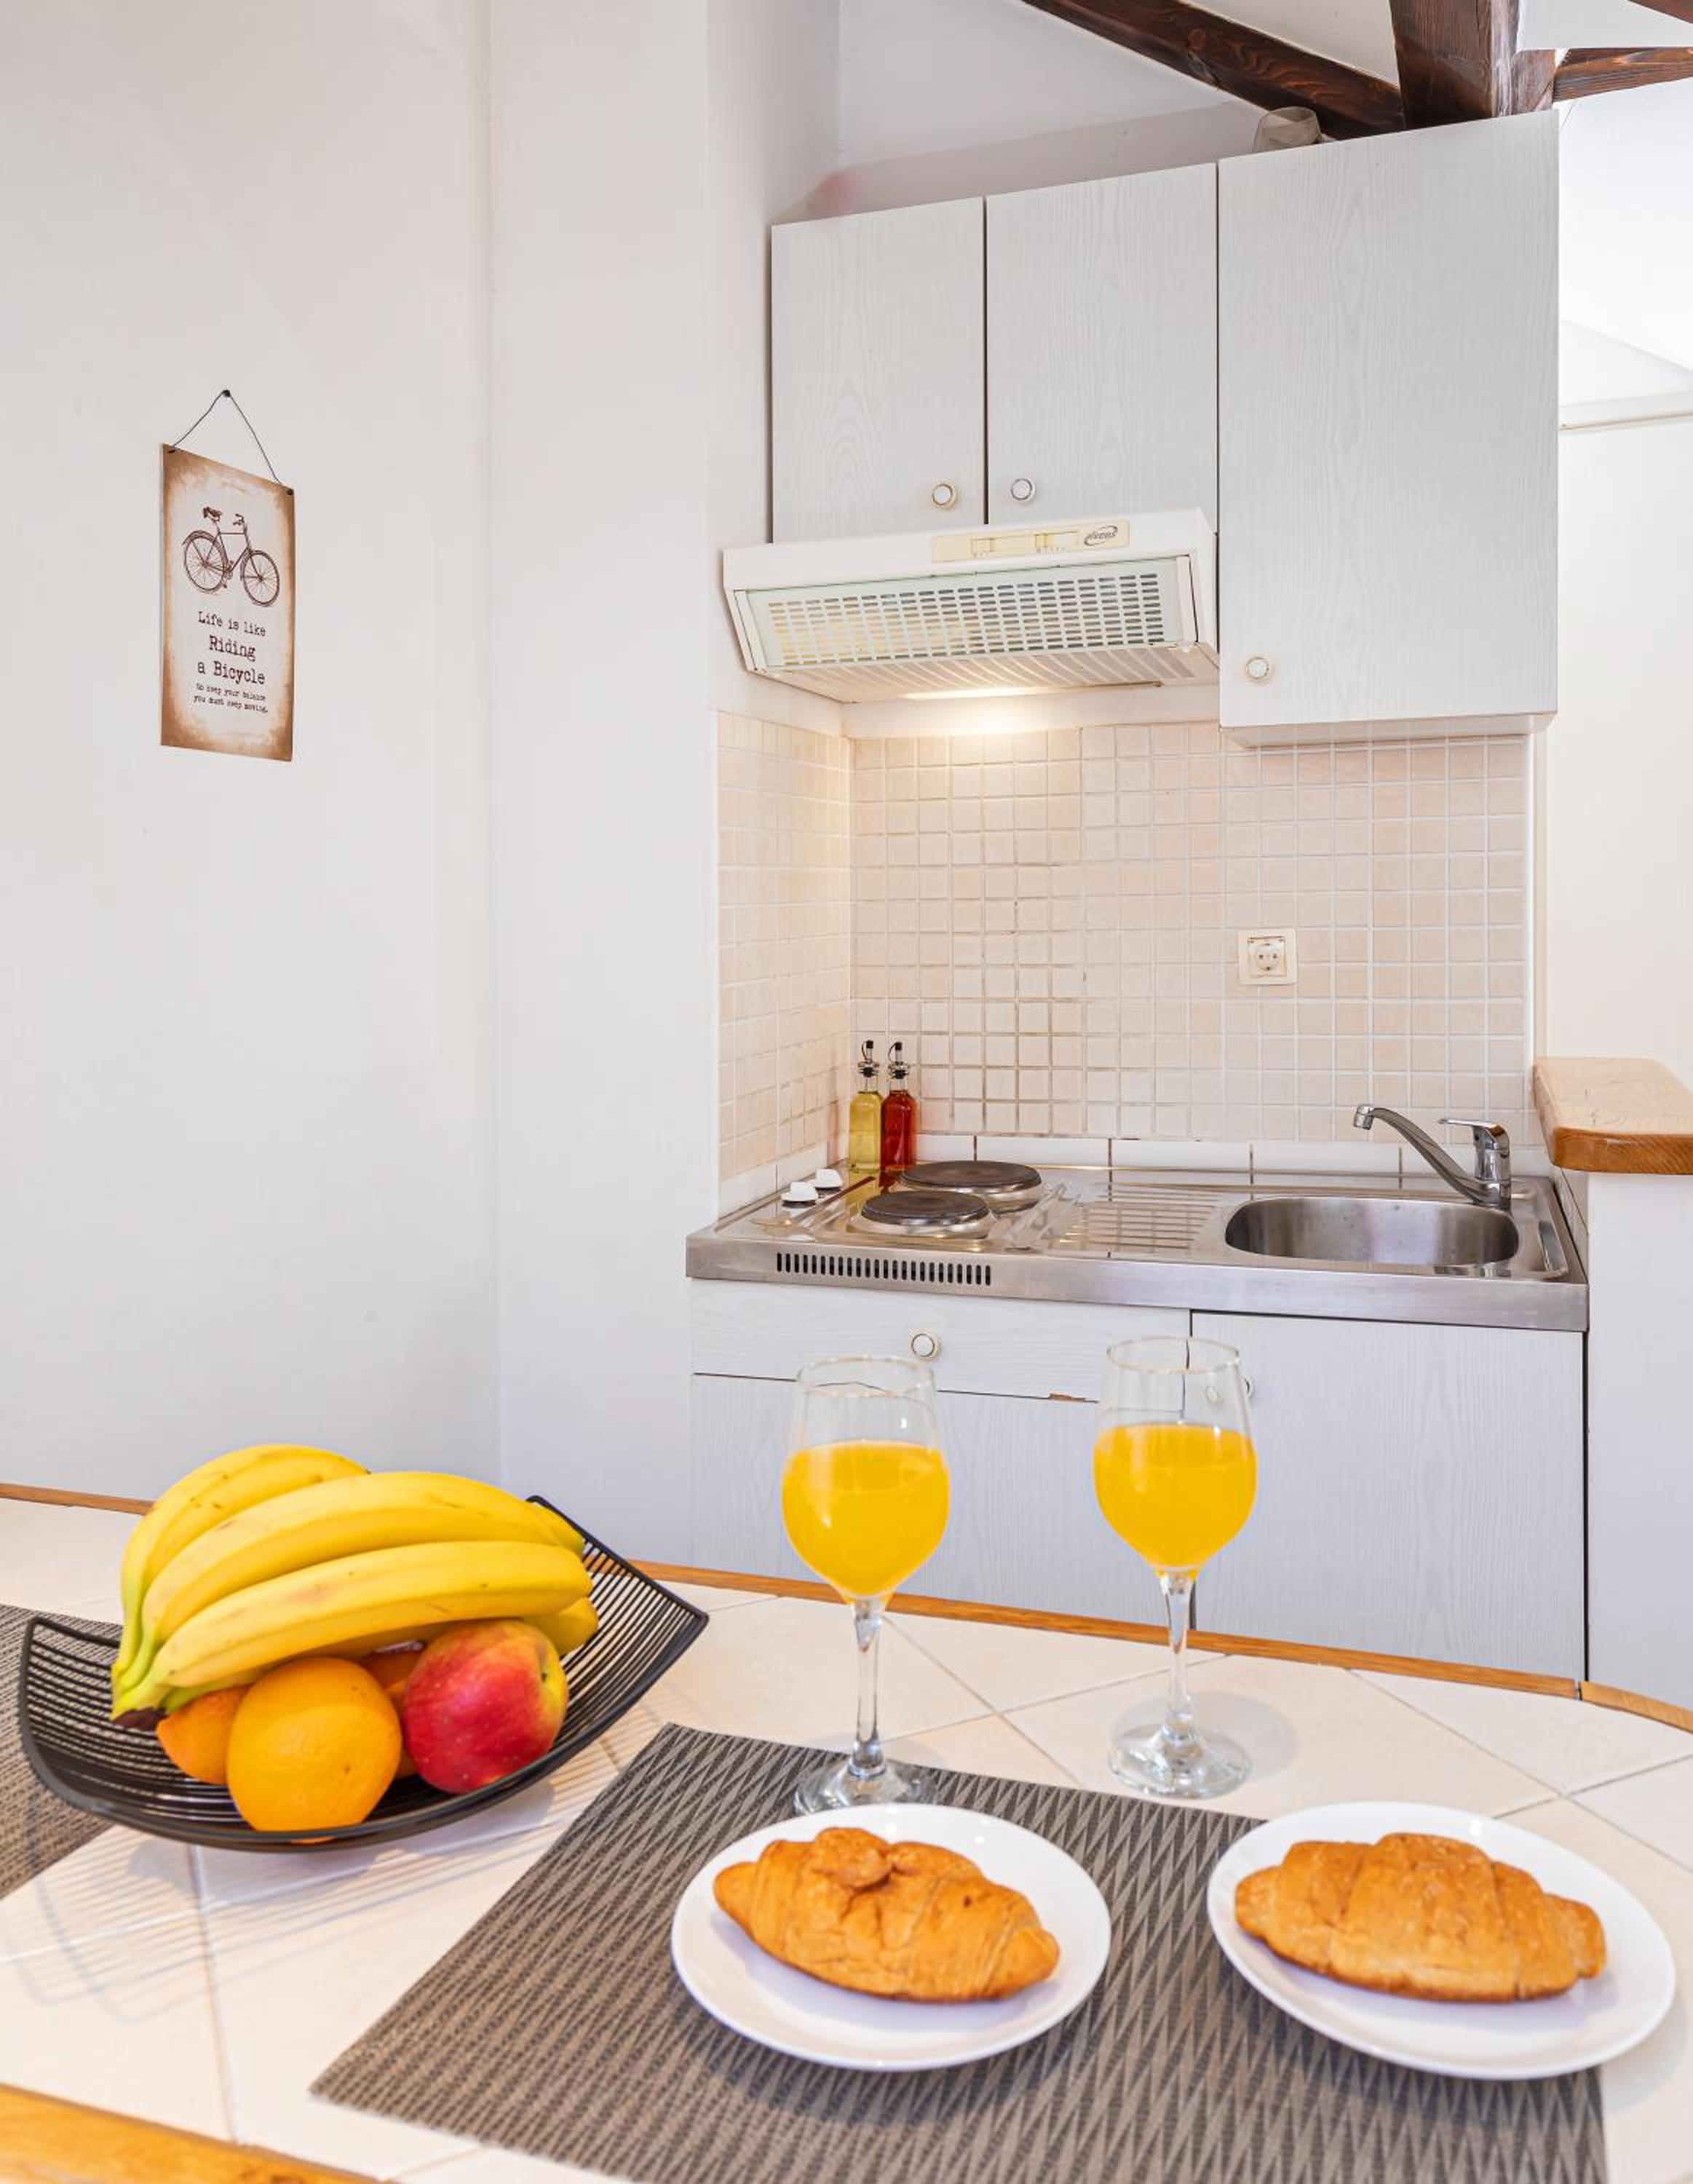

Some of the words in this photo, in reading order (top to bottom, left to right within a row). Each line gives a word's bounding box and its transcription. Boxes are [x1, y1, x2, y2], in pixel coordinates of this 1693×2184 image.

[198, 611, 222, 627] Life
[229, 617, 239, 630] is
[244, 621, 266, 637] like
[209, 635, 255, 662] Riding
[197, 662, 205, 674] a
[213, 660, 265, 684] Bicycle
[196, 683, 204, 691] to
[243, 692, 266, 702] balance
